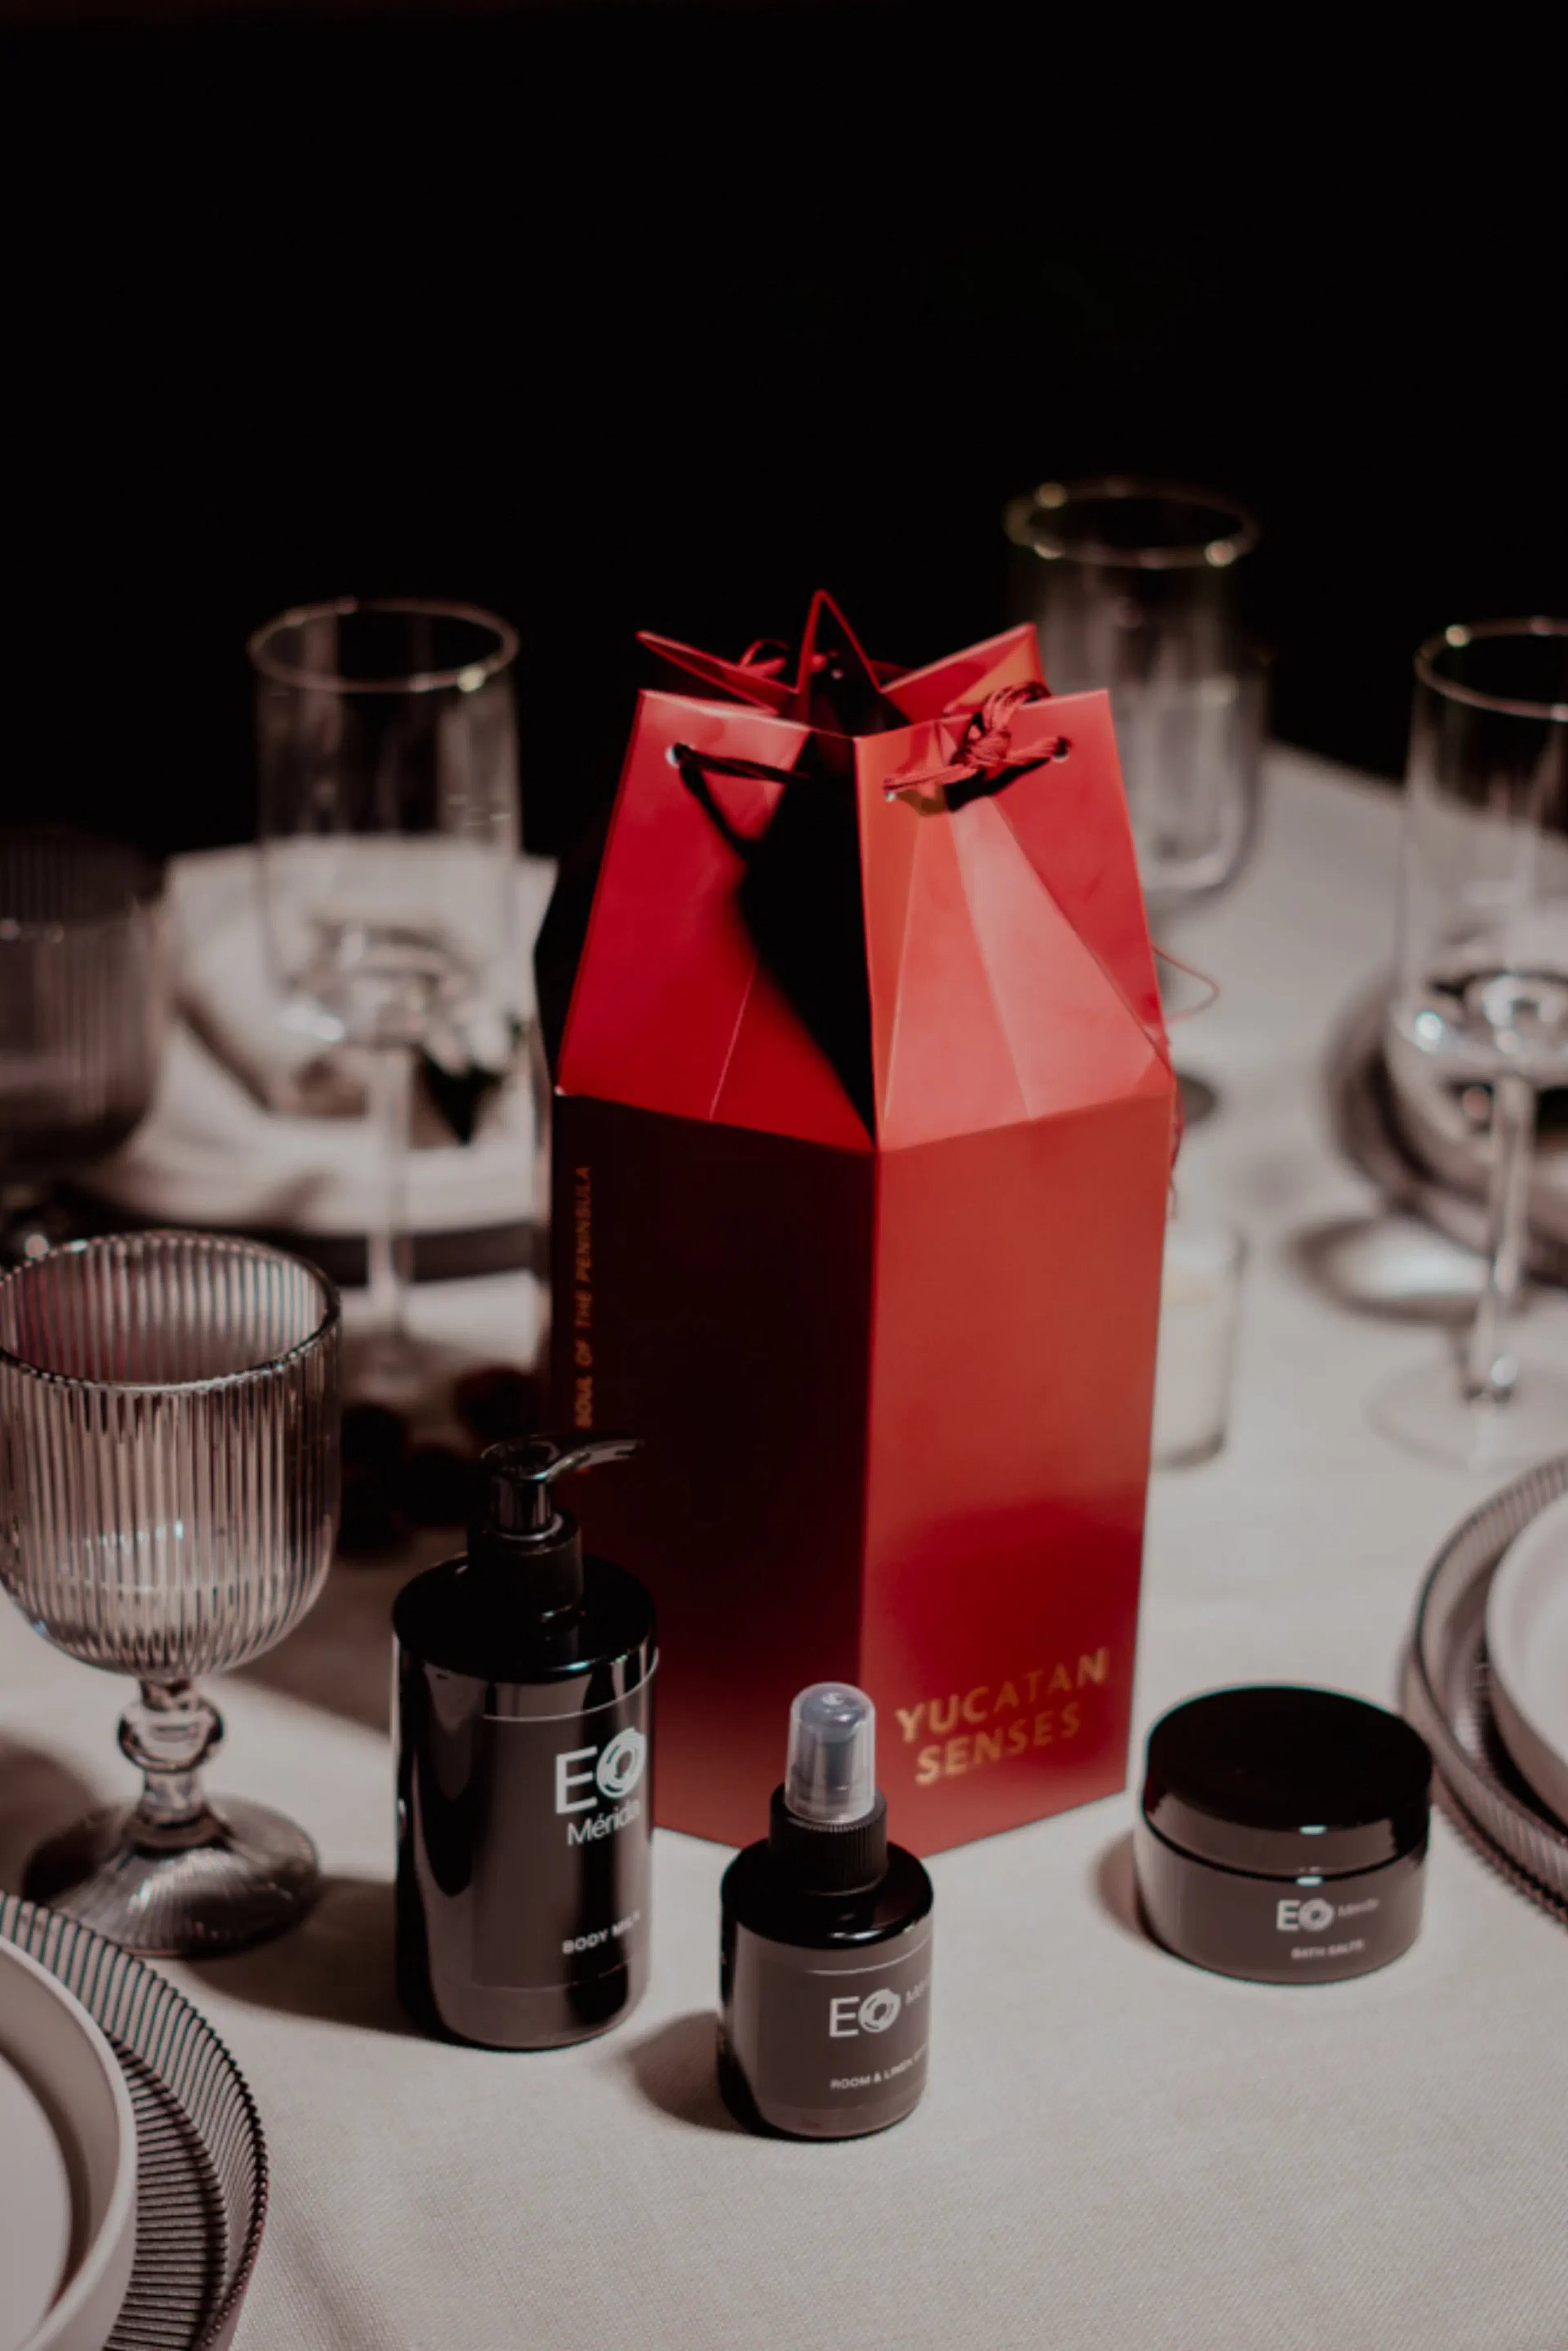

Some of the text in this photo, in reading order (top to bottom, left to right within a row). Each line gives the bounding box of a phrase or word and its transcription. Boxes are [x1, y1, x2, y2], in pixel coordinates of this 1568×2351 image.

[574, 1166, 592, 1282] PENINSULA
[574, 1289, 592, 1328] THE
[574, 1340, 592, 1366] OF
[895, 1647, 1109, 1744] YUCATAN
[914, 1701, 1081, 1787] SENSES
[562, 1928, 608, 1955] BODY
[830, 2074, 870, 2090] ROOM
